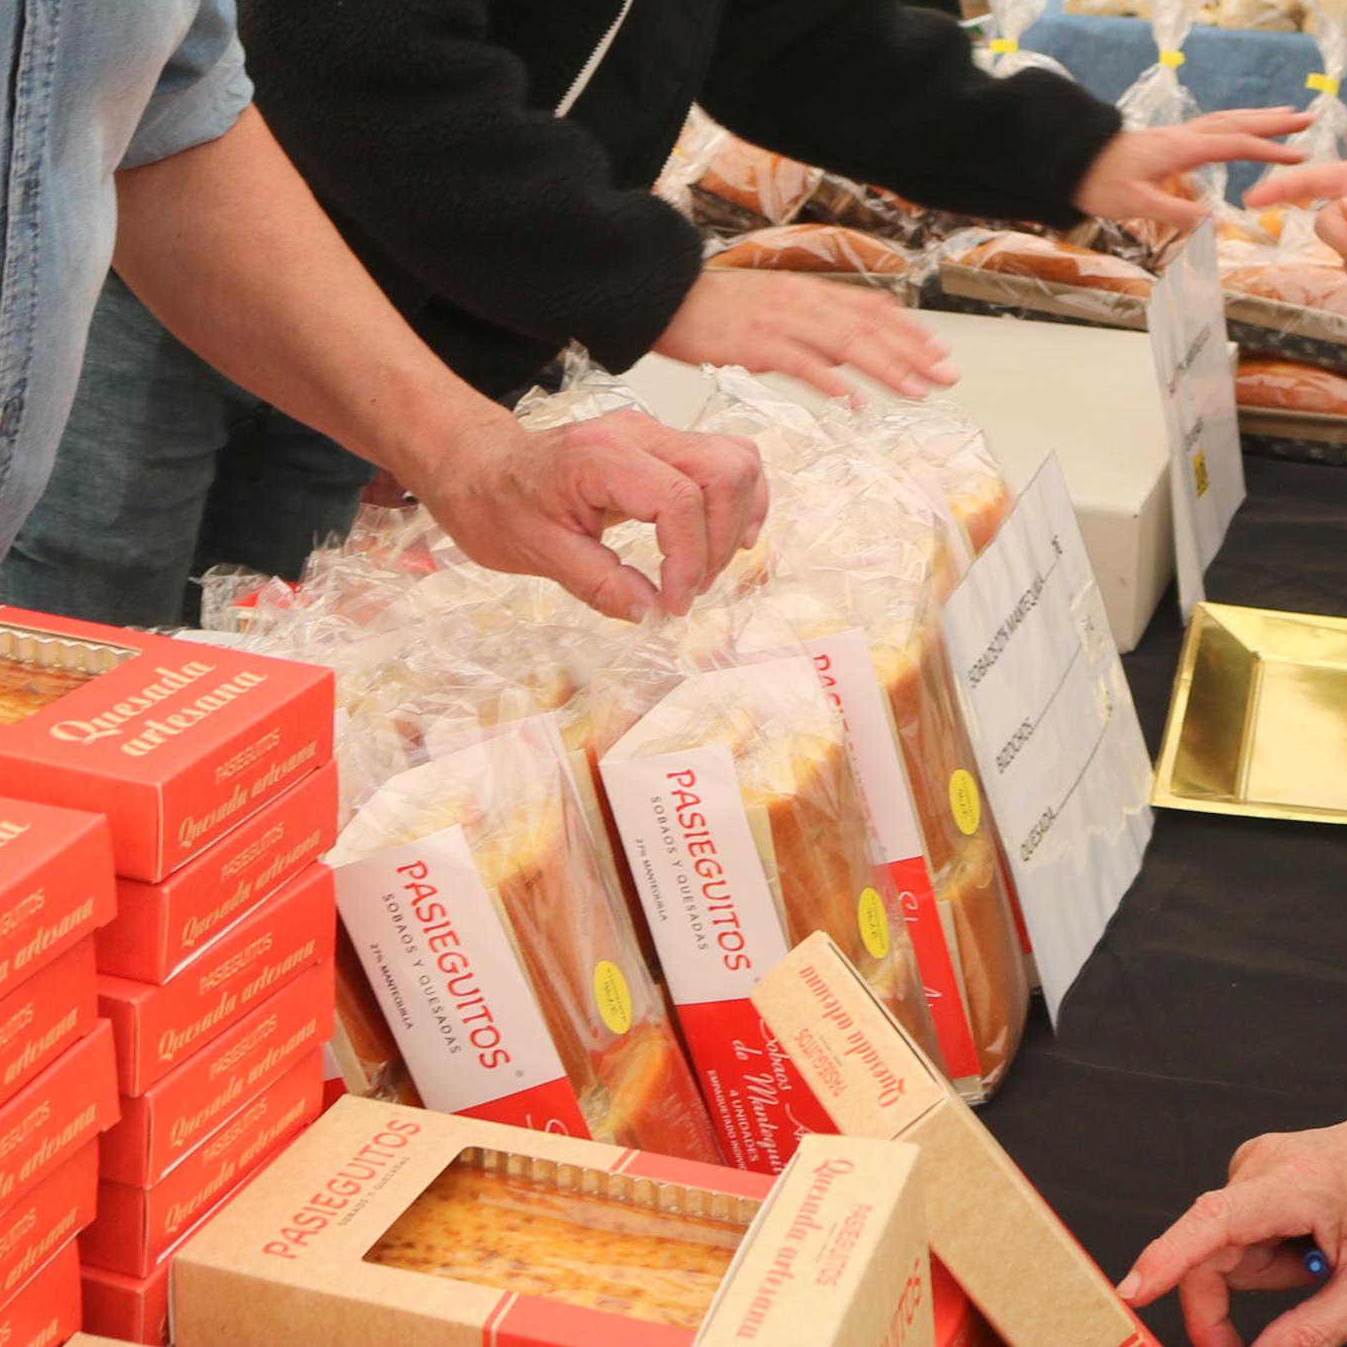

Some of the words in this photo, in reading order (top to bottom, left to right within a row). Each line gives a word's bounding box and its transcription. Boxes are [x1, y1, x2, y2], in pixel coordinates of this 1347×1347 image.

[49, 660, 218, 744] Quesada
[121, 668, 269, 757] artesana
[178, 783, 248, 849] Quesada
[252, 740, 317, 799] artesana
[650, 795, 678, 856] SOBAOS
[181, 879, 253, 948] Quesada
[256, 830, 321, 892] artesana
[642, 858, 669, 923] MANTEQUILLA
[667, 769, 753, 972] PASIEGUITOS
[673, 859, 683, 868] Y
[14, 897, 96, 971] artesana
[675, 876, 710, 952] QUESADAS
[158, 991, 236, 1061] Quesada
[241, 939, 317, 1002] artesana
[199, 932, 274, 997] PASIEGUITOS
[369, 943, 387, 970] 27%
[380, 970, 414, 1031] MANTEQUILLA
[382, 893, 418, 954] SOBAOS
[412, 959, 424, 968] Y
[419, 975, 462, 1056] QUESADAS
[397, 860, 510, 1070] PASIEGUITOS
[798, 964, 854, 1034] artesana
[5, 1006, 79, 1078] artesana
[170, 1075, 244, 1148] Quesada
[249, 1018, 317, 1086] artesana
[732, 1040, 763, 1060] de
[793, 1027, 847, 1098] PASIEGUITOS
[846, 1031, 908, 1109] Quesada
[20, 1103, 98, 1182] artesana
[708, 1070, 737, 1140] EMPAQUETADO
[732, 1099, 760, 1162] UNIDADES
[743, 1073, 787, 1172] Mantequi
[164, 1156, 235, 1234] Quesada
[239, 1098, 307, 1166] artesana
[262, 1119, 422, 1259] PASIEGUITOS
[785, 1158, 855, 1241] Quesada
[5, 1206, 79, 1286] artesana
[815, 1203, 873, 1288] PASIEGUITOS
[736, 1238, 797, 1340] artesana
